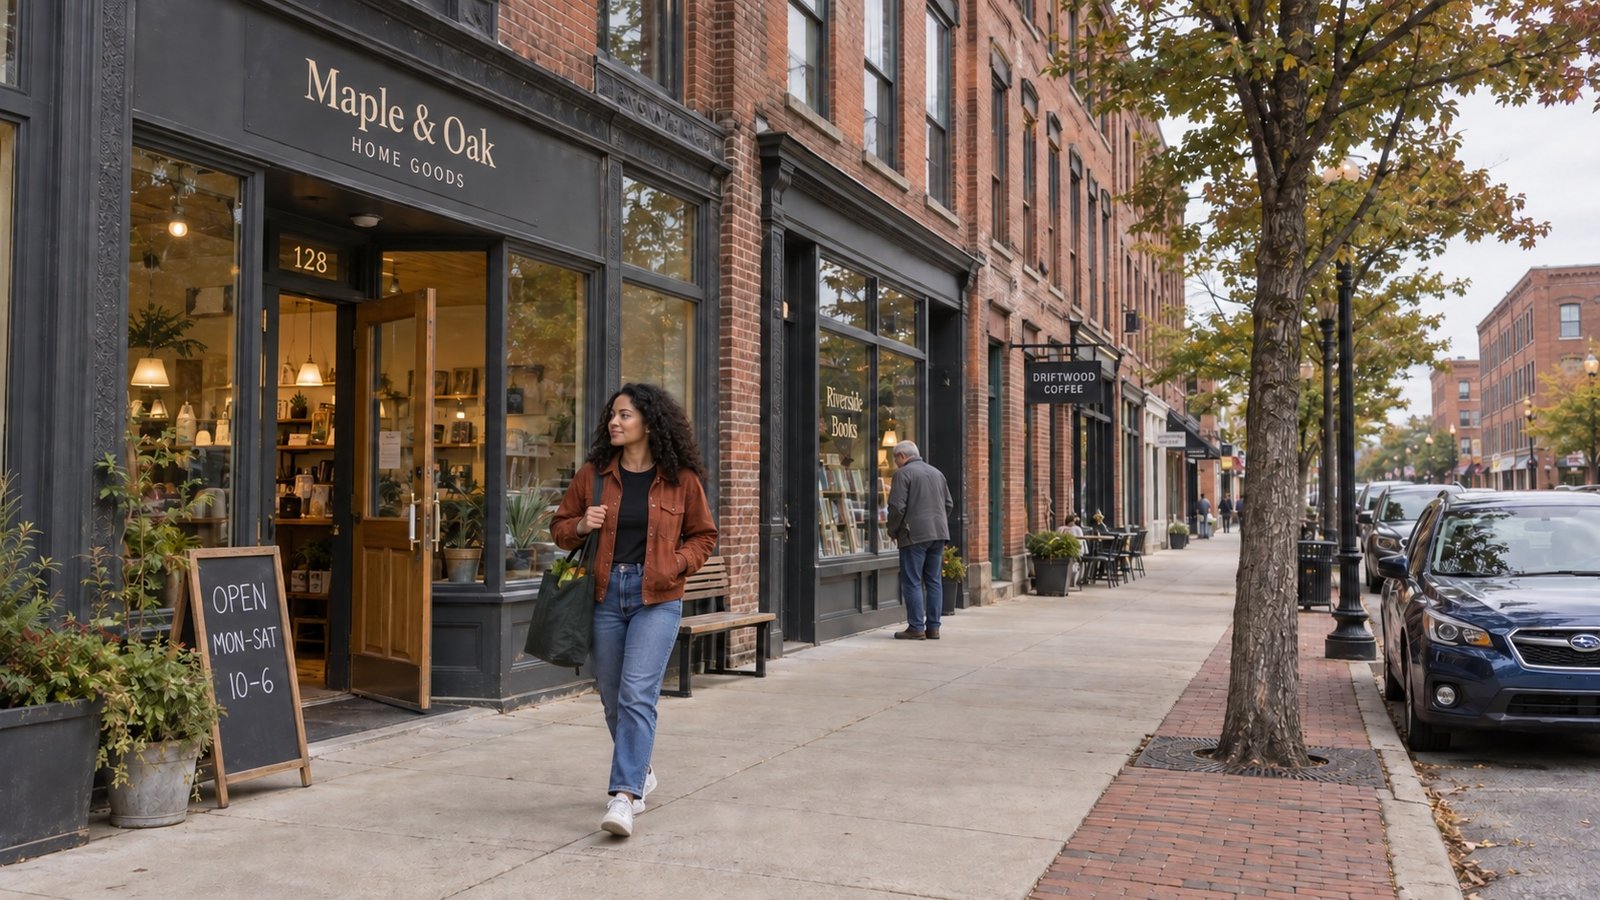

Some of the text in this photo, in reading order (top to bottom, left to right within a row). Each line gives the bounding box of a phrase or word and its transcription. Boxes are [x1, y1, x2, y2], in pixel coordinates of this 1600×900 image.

[304, 57, 497, 169] Maple & Oak
[351, 136, 464, 189] HOME GOODS
[294, 245, 327, 273] 128
[1033, 372, 1096, 382] DRIFTWOOD
[1044, 384, 1083, 394] COFFEE
[826, 385, 863, 412] Riverside
[831, 414, 858, 439] Books
[212, 582, 267, 614] OPEN
[213, 626, 277, 656] MON-SAT
[229, 667, 274, 700] 10-6
